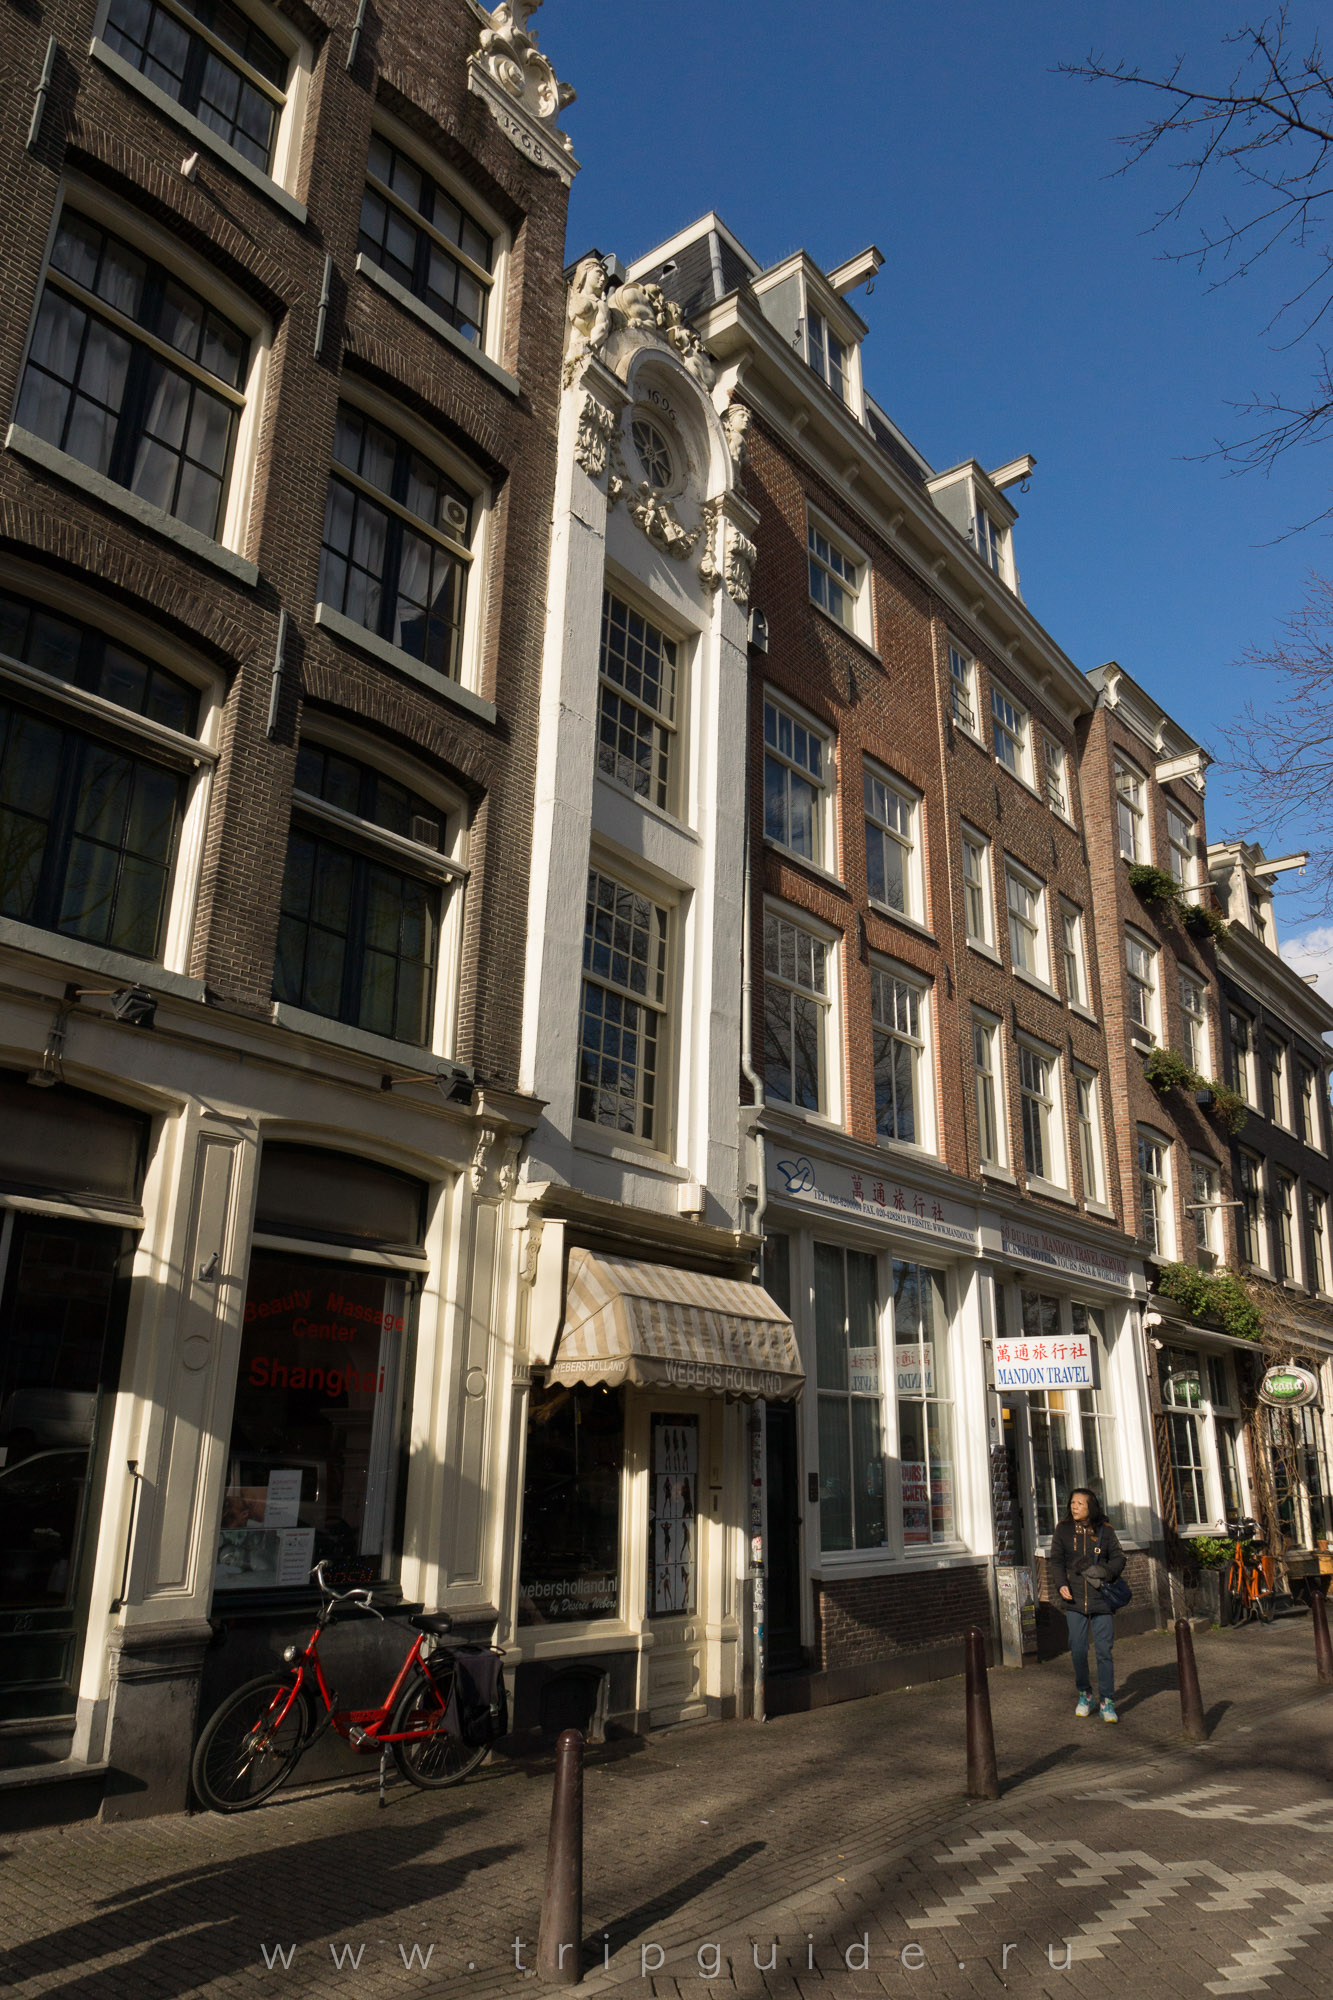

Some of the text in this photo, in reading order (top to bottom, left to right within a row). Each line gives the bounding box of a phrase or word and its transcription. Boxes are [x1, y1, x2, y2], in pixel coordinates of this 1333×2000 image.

[503, 116, 543, 162] 1768
[647, 388, 677, 421] 1696
[850, 1174, 945, 1222] 萬通旅行社
[1030, 1249, 1056, 1266] HOTELS
[1041, 1235, 1074, 1258] MANDON
[1073, 1245, 1100, 1267] TRAVEL
[1100, 1253, 1129, 1274] SERVICE
[244, 1288, 405, 1331] Beauty Massage
[292, 1317, 358, 1342] Center
[553, 1360, 625, 1374] WEBERS HOLLAND
[996, 1342, 1088, 1363] 萬通旅行社
[248, 1356, 386, 1398] Shanghai
[664, 1358, 782, 1394] WEBERS HOLLAND
[997, 1366, 1090, 1385] MANDON TRAVEL
[1264, 1378, 1304, 1394] Brand
[549, 1599, 559, 1616] by
